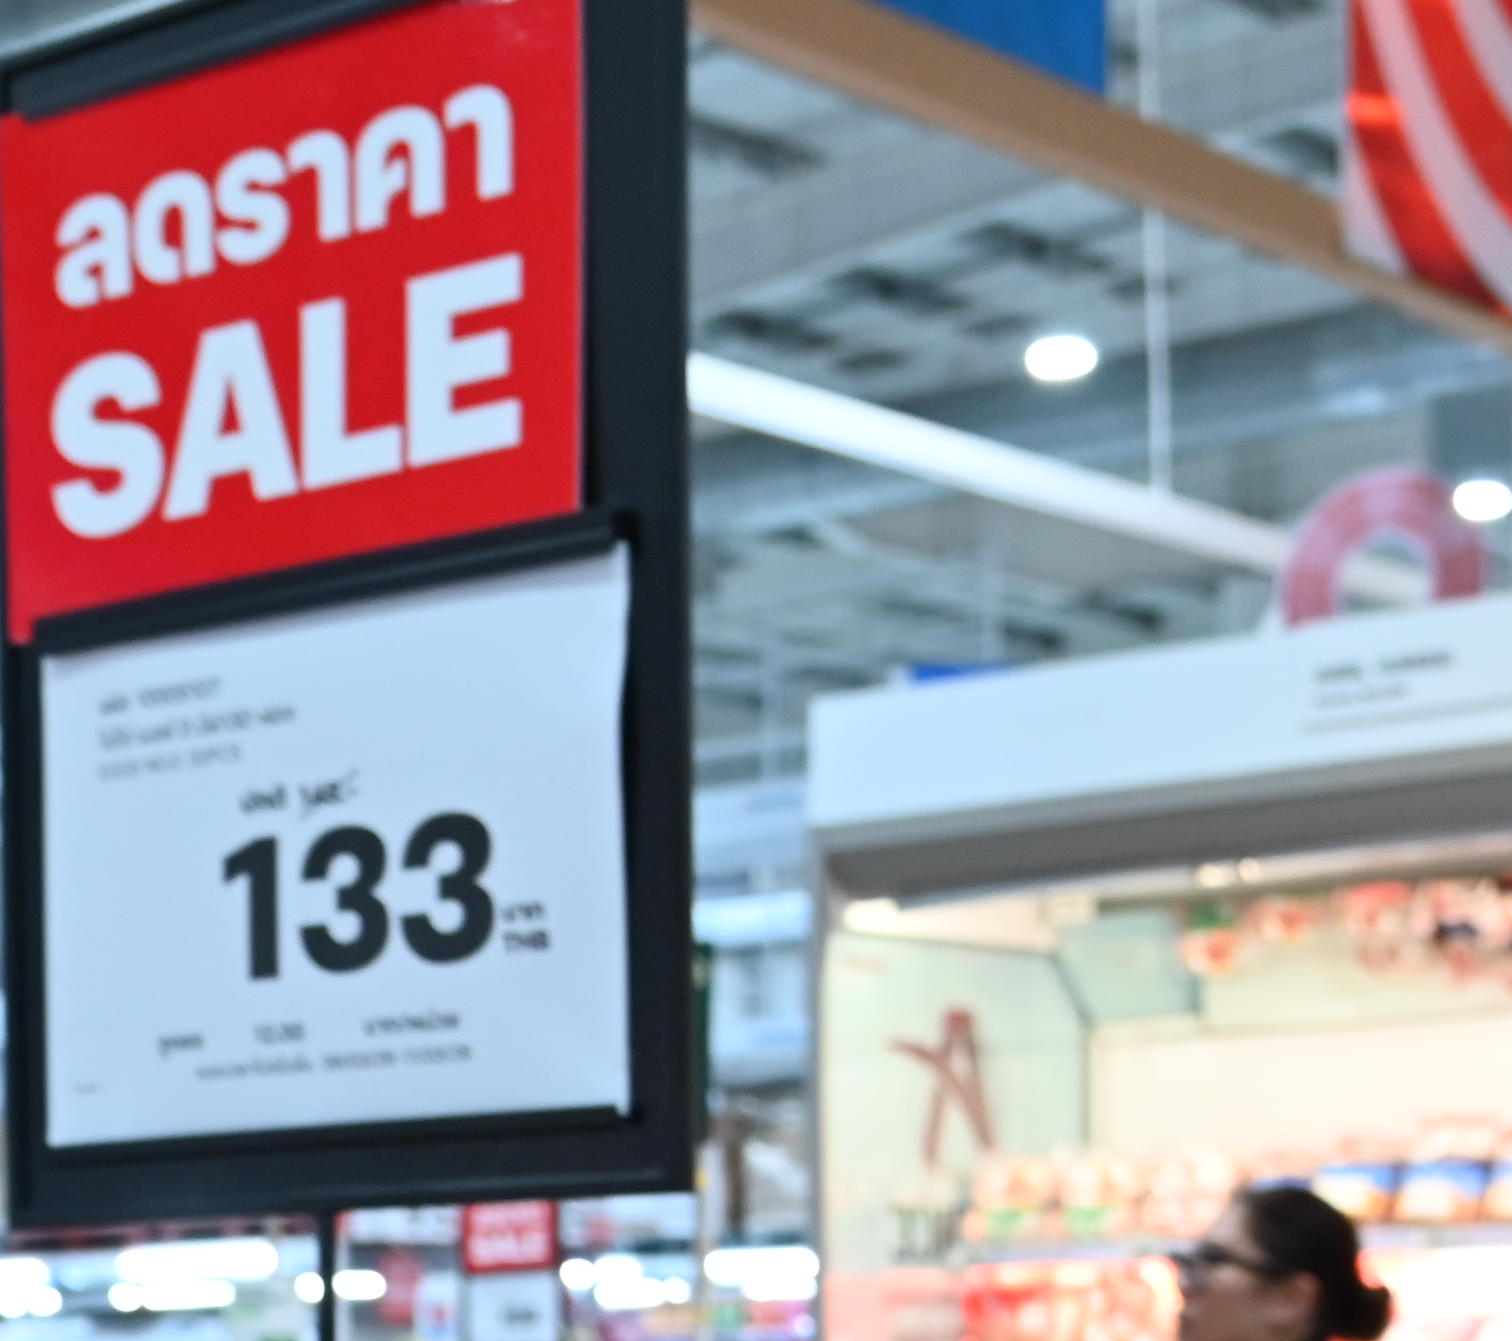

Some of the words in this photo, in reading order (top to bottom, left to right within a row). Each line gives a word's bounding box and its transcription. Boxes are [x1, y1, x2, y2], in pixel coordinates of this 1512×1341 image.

[55, 84, 513, 309] ลดราคา
[50, 252, 523, 540] SALE
[223, 812, 494, 981] 133
